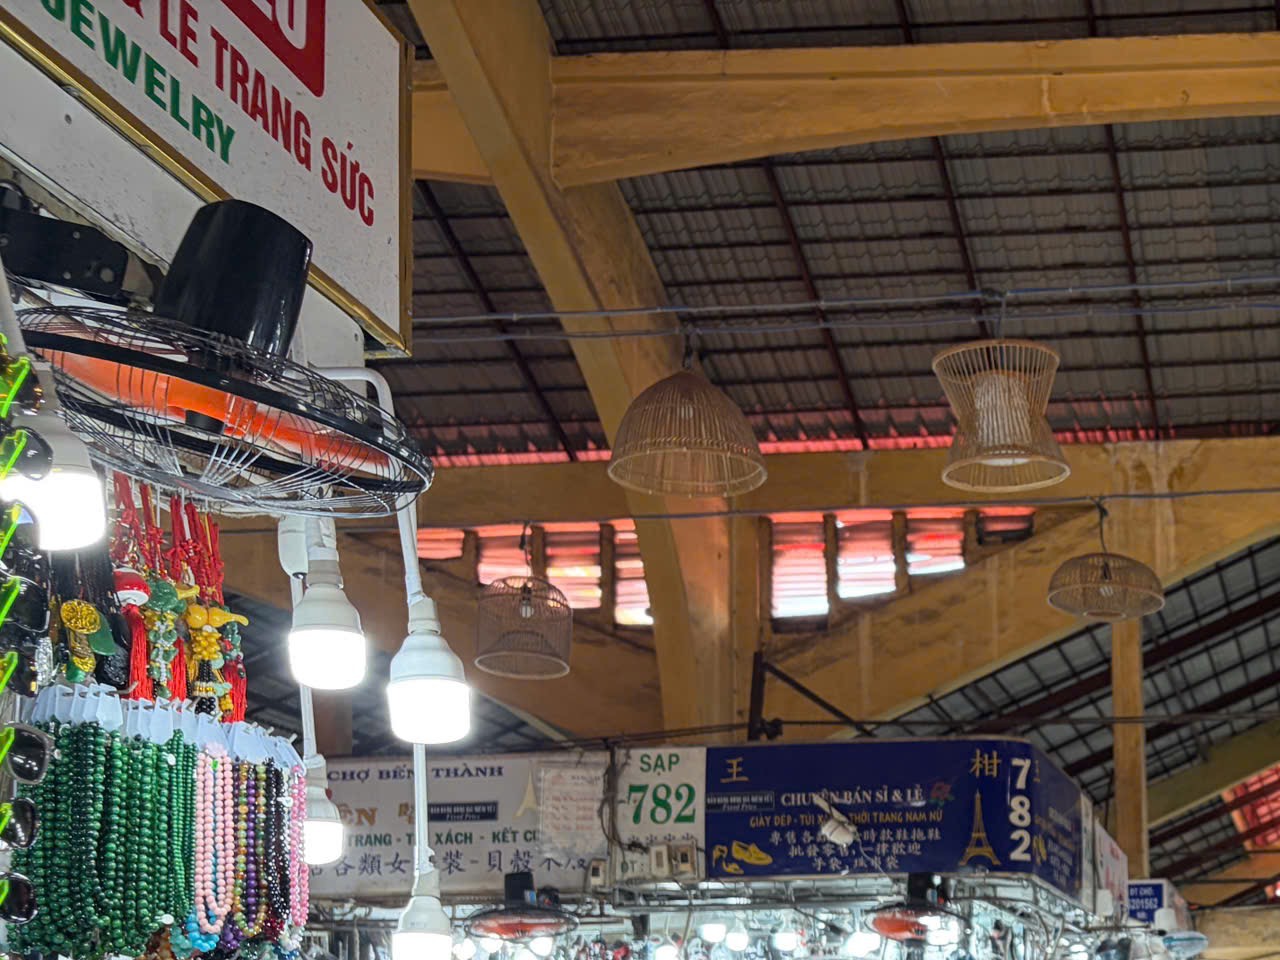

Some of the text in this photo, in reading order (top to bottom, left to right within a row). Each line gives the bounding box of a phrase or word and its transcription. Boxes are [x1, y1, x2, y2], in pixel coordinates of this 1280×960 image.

[210, 25, 312, 171] TRANG
[321, 136, 374, 227] SỨC
[327, 768, 369, 783] CHỢ
[432, 763, 504, 779] THÀNH
[640, 753, 680, 776] SẠP
[627, 783, 696, 825] 782
[1009, 758, 1032, 862] 782
[434, 828, 473, 846] XÁCH
